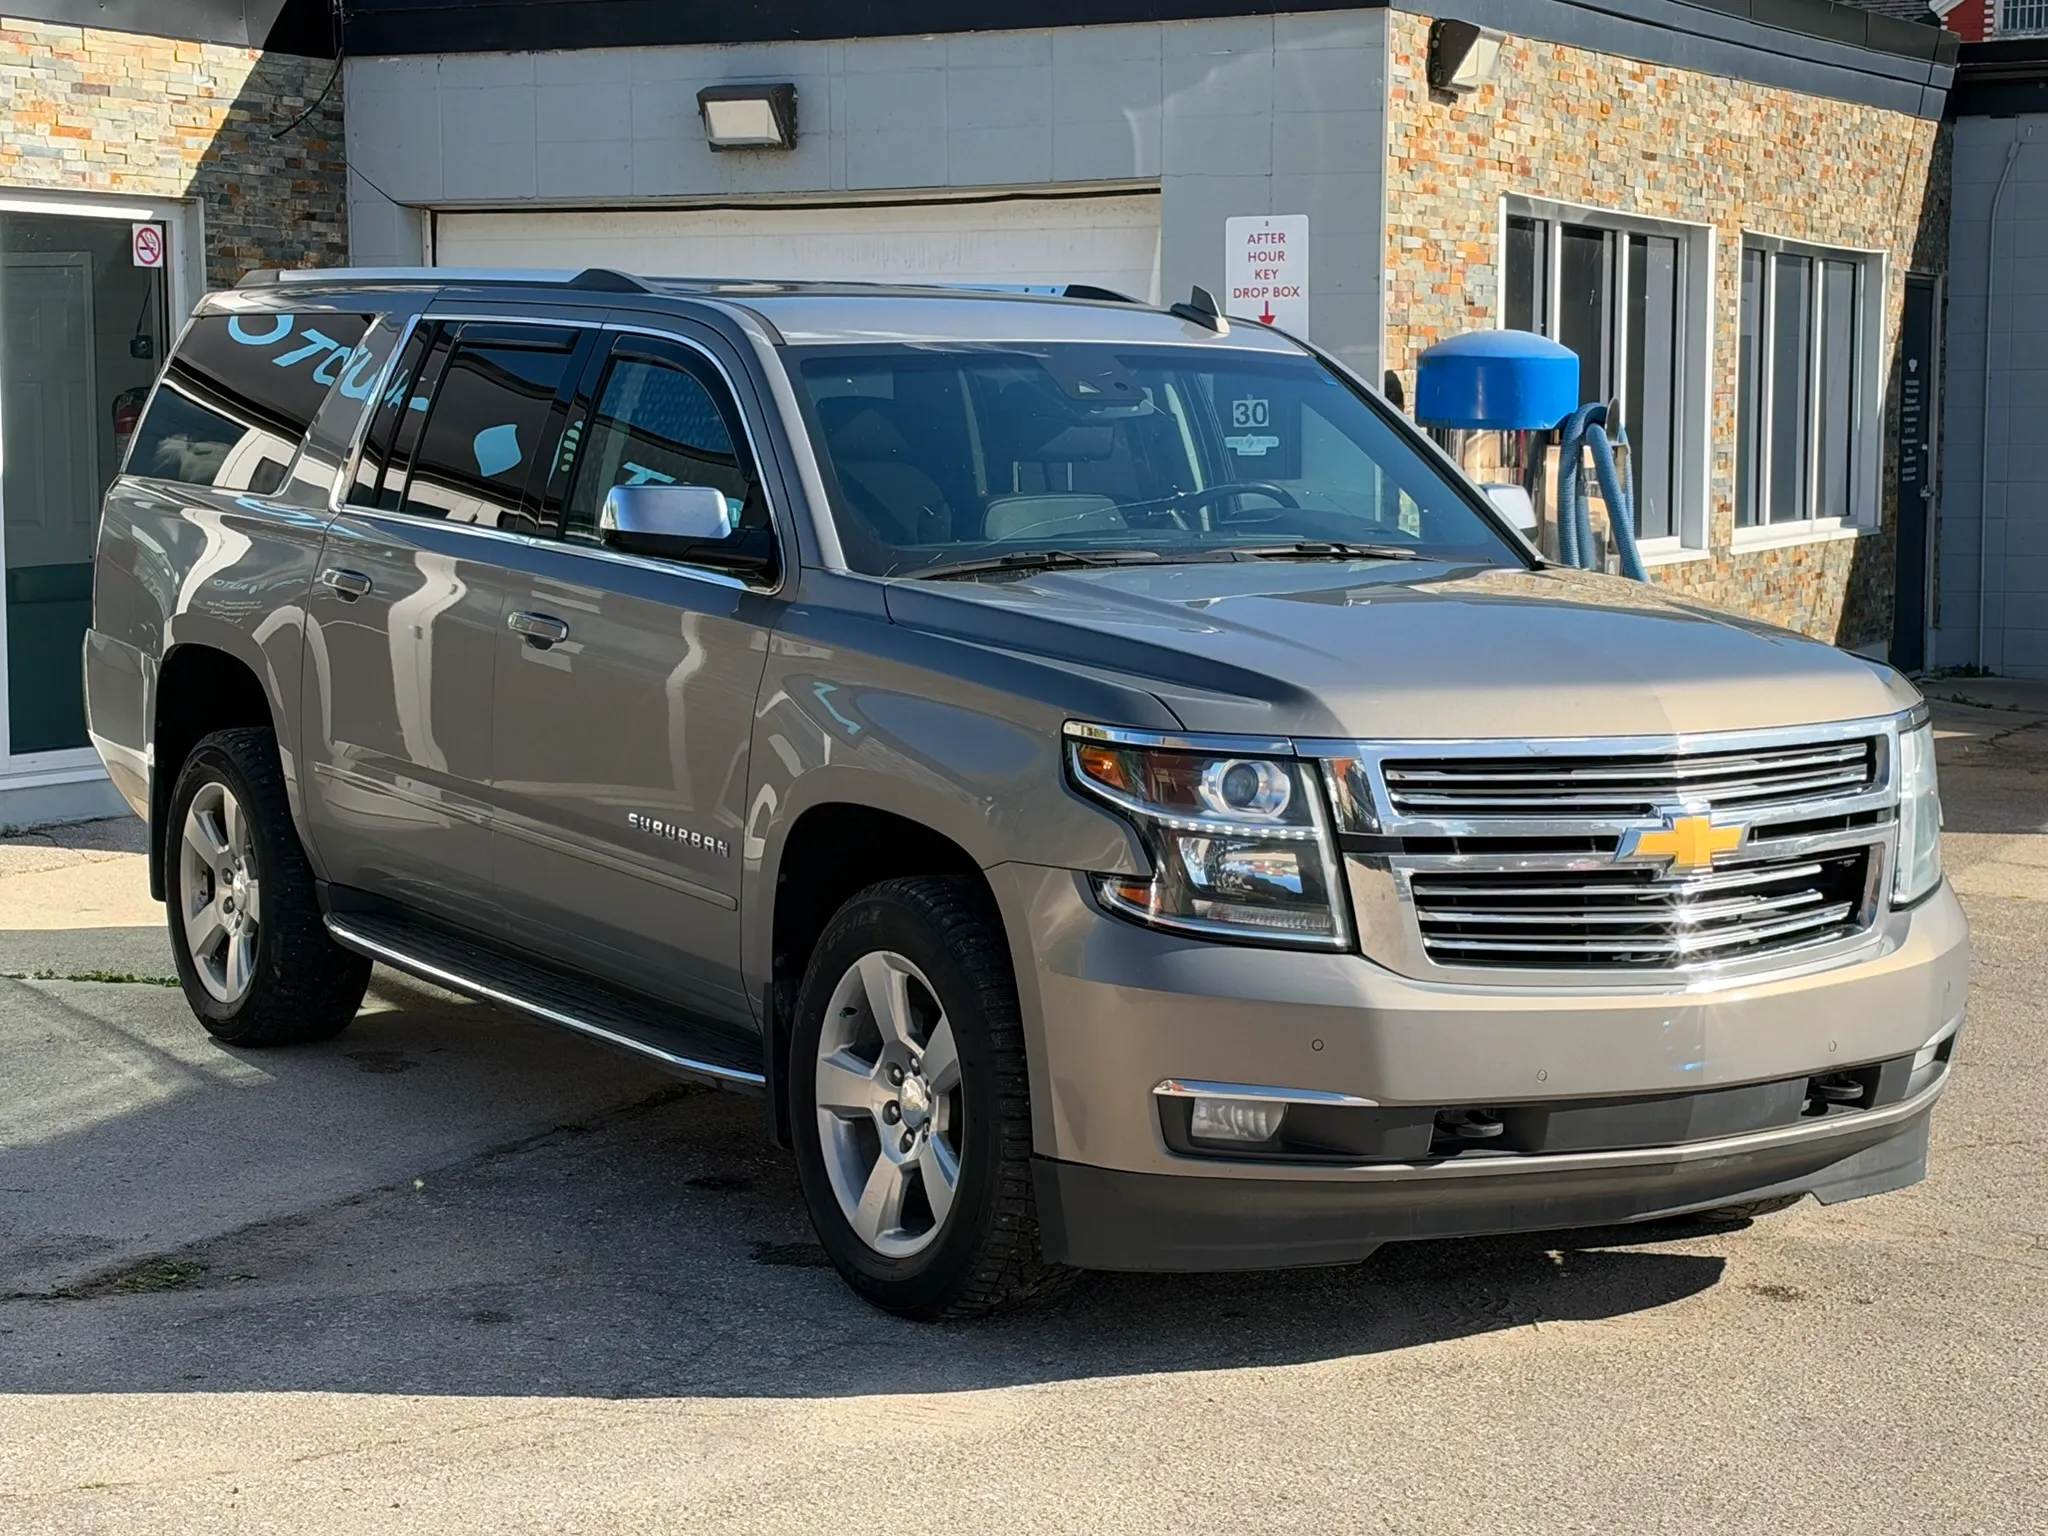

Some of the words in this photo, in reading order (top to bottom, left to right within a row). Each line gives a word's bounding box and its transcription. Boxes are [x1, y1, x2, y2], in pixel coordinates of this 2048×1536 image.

[1247, 232, 1286, 245] AFTER
[1247, 250, 1286, 263] HOUR
[1254, 269, 1279, 280] KEY
[1233, 287, 1269, 299] DROP
[1272, 286, 1300, 298] BOX
[1234, 401, 1268, 426] 30
[628, 812, 730, 859] SUBURBAN
